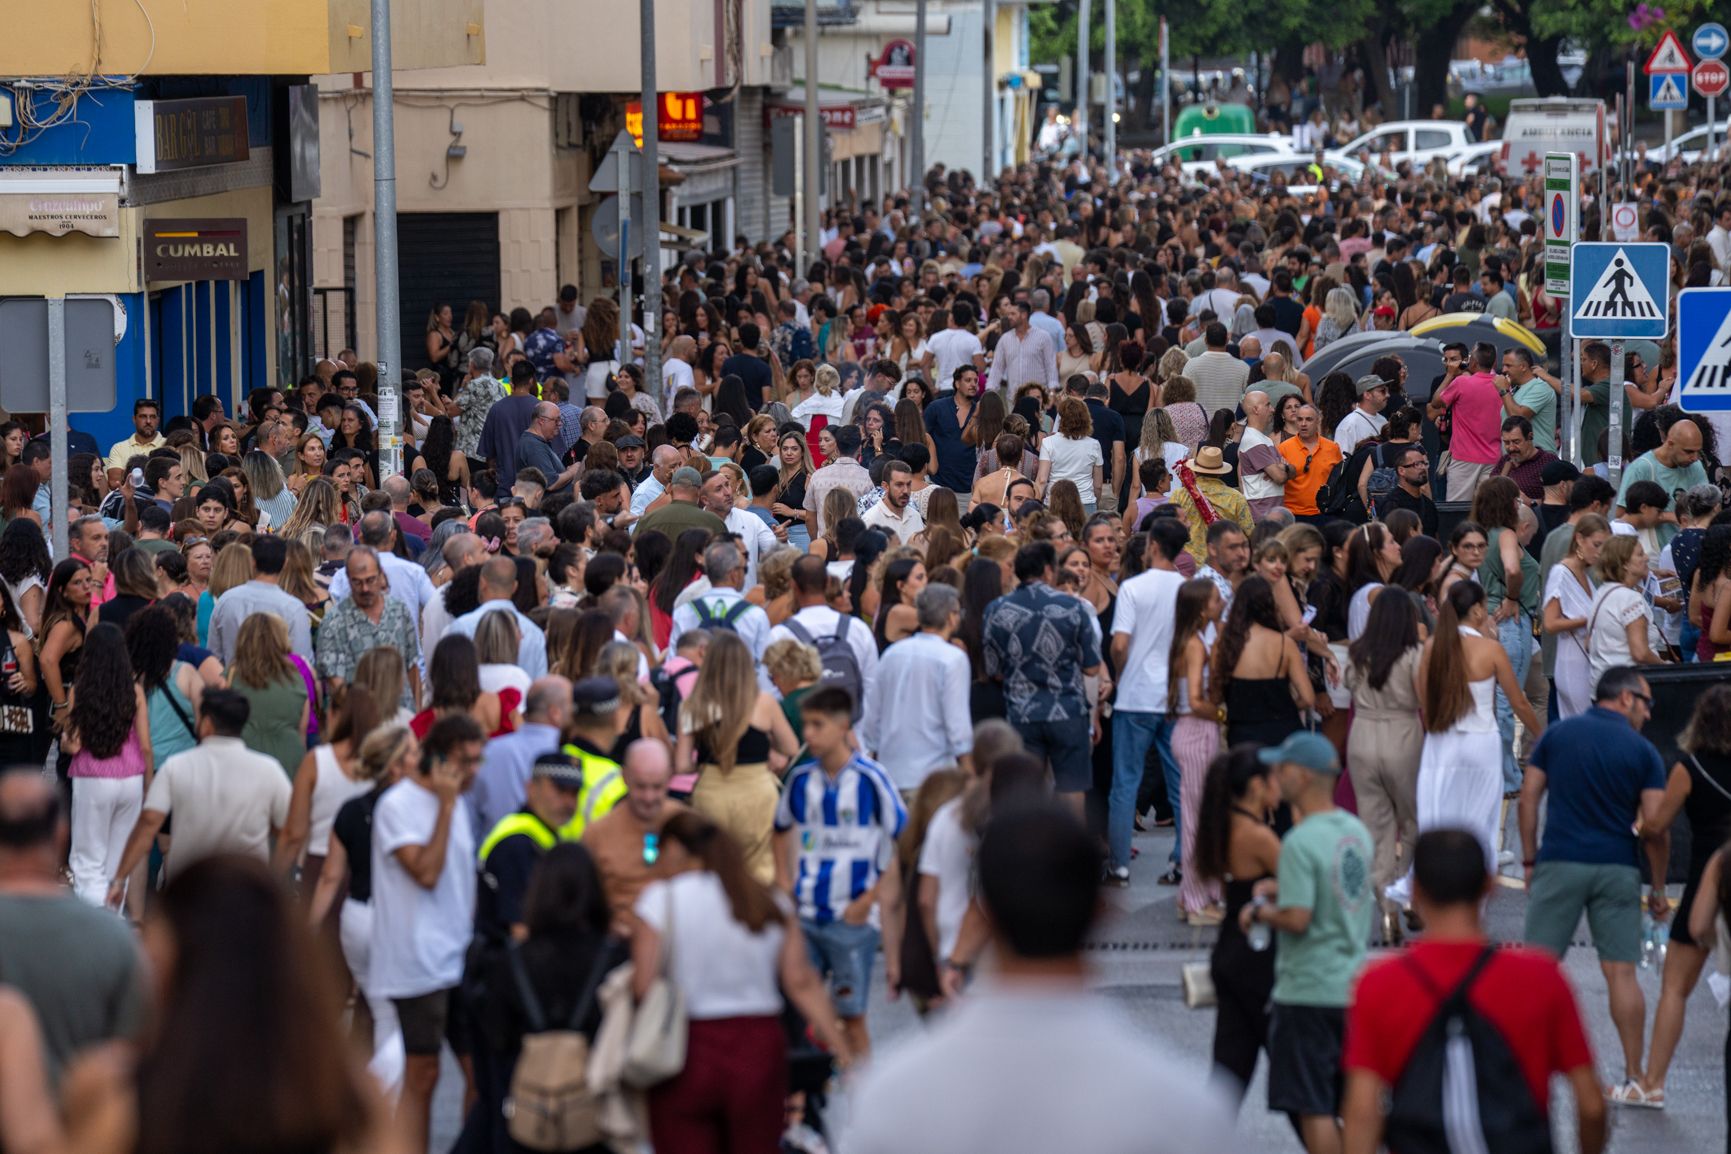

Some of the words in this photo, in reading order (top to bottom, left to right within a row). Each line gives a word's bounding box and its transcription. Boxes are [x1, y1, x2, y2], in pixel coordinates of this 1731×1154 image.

[1696, 71, 1726, 85] STOP
[156, 112, 178, 160] BAR
[156, 243, 240, 257] CUMBAL
